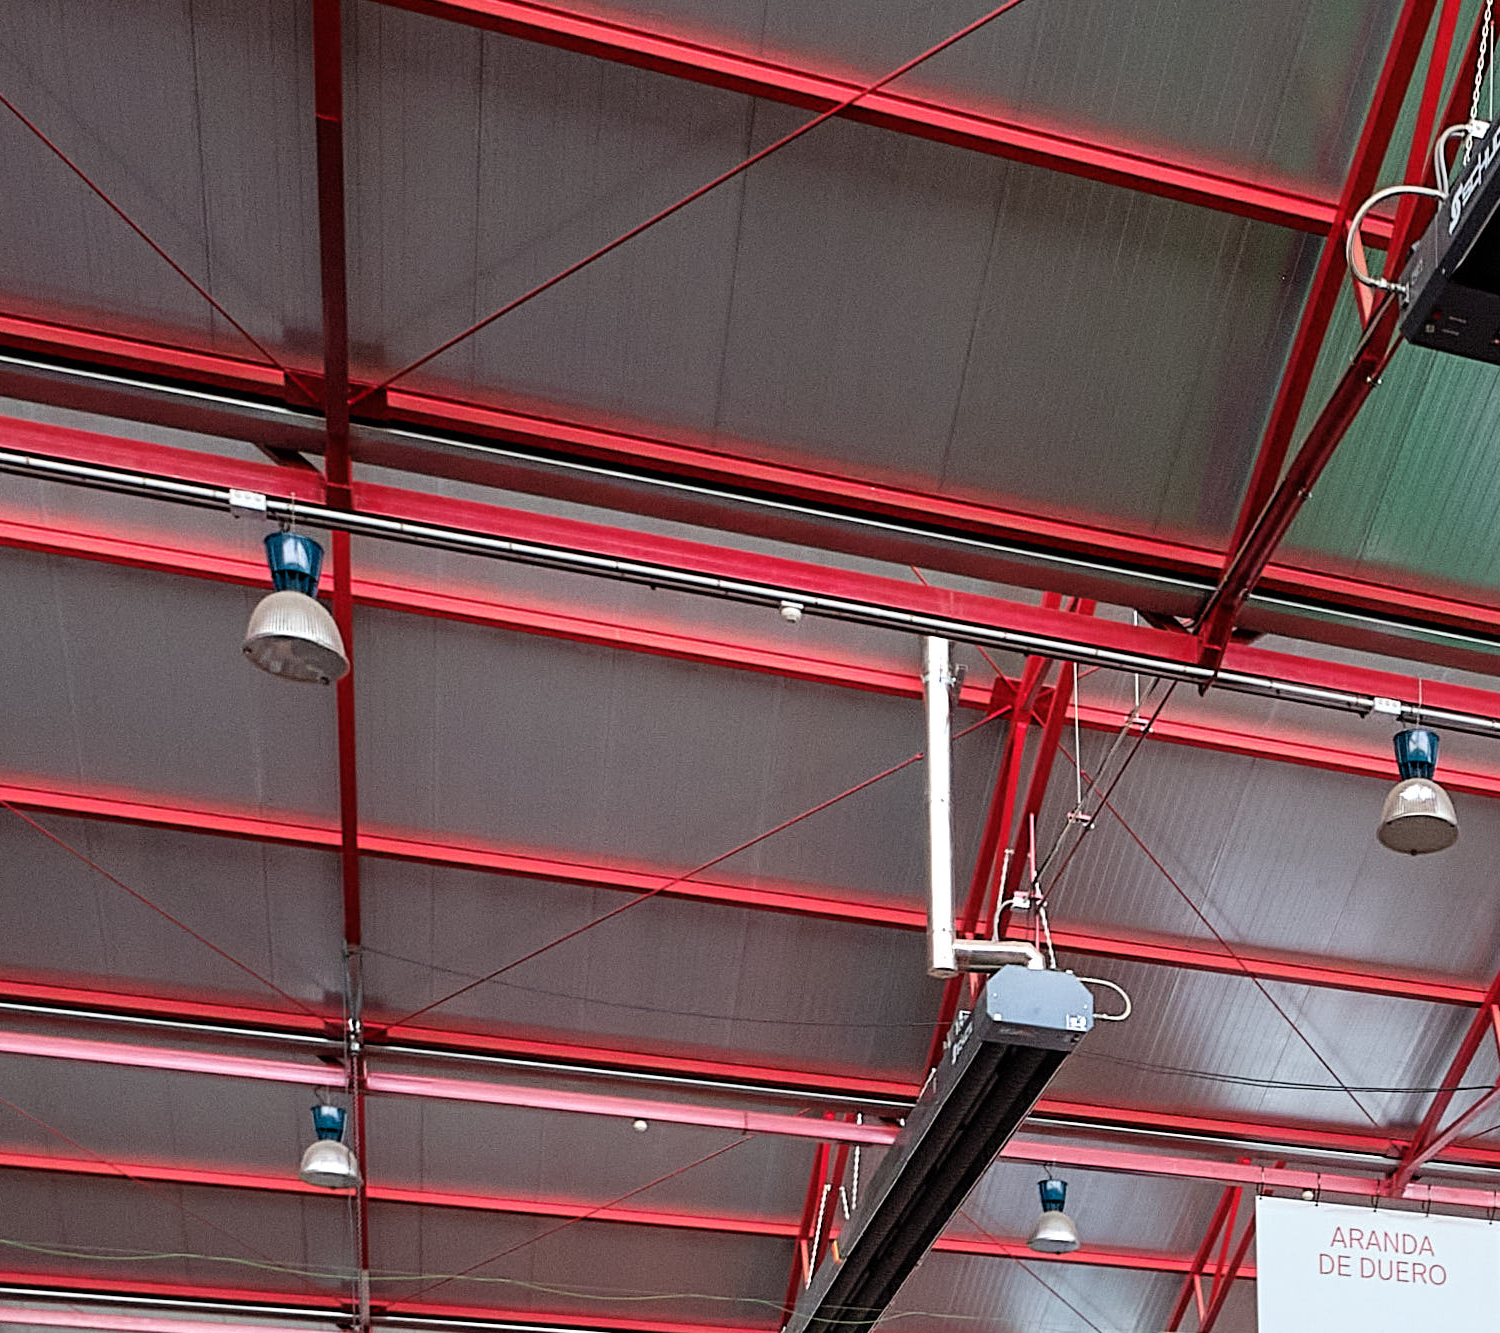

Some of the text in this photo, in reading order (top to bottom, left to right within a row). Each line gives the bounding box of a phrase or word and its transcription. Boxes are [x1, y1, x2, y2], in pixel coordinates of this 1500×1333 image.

[1330, 1226, 1435, 1258] ARANDA
[1318, 1253, 1448, 1287] DE DUERO
